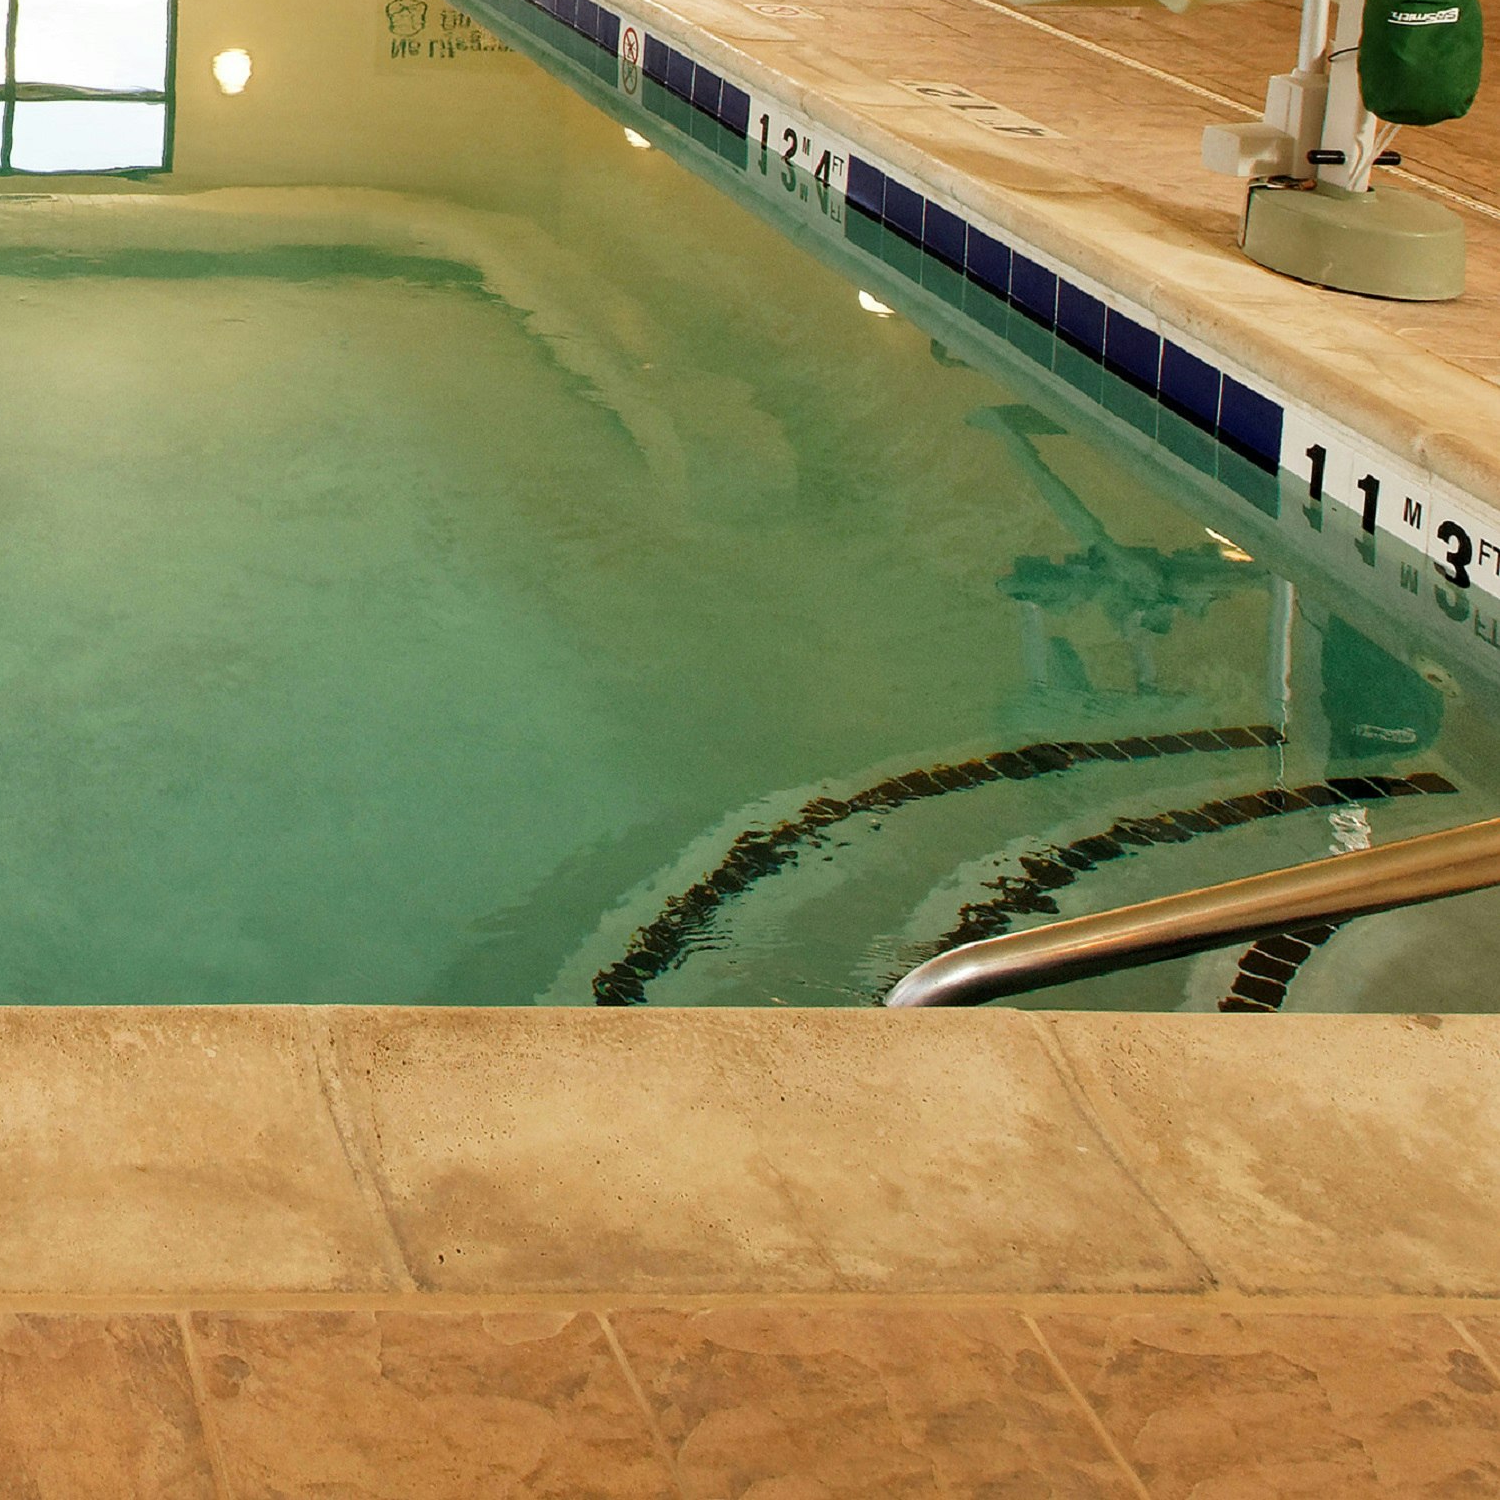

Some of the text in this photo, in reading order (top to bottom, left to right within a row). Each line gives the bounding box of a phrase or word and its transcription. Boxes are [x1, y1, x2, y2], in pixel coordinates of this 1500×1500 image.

[802, 136, 811, 156] M
[814, 149, 831, 188] 4
[832, 155, 845, 176] FT
[1403, 496, 1422, 529] M
[1434, 520, 1473, 588] 3
